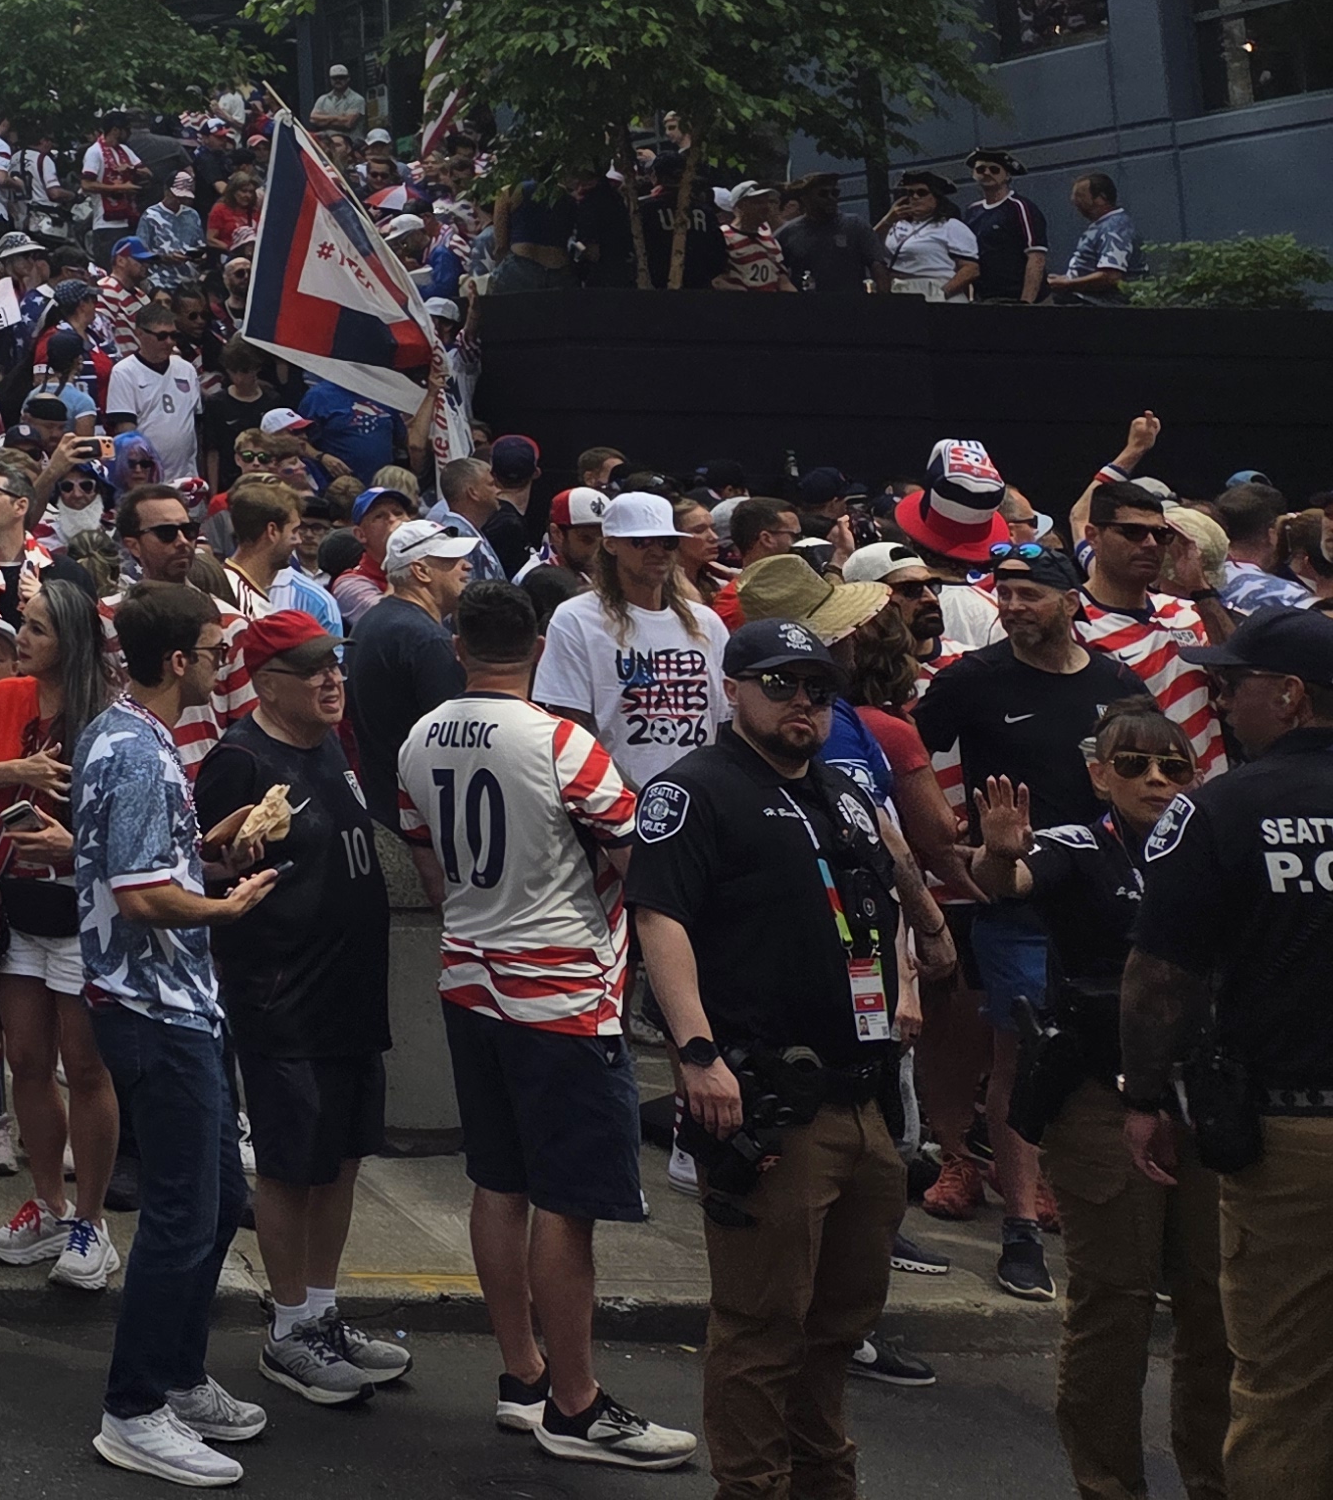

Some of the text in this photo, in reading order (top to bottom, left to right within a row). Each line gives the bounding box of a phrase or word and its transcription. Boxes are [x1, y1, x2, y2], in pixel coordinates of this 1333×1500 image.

[659, 207, 707, 233] UA
[750, 263, 770, 282] 20
[162, 394, 176, 414] 8
[616, 648, 707, 680] UNITED
[620, 680, 709, 714] STATES
[425, 721, 499, 749] PULISIC
[648, 786, 681, 803] SEATTLE
[431, 767, 506, 890] 10
[641, 819, 668, 835] POLICE
[345, 826, 372, 880] 10
